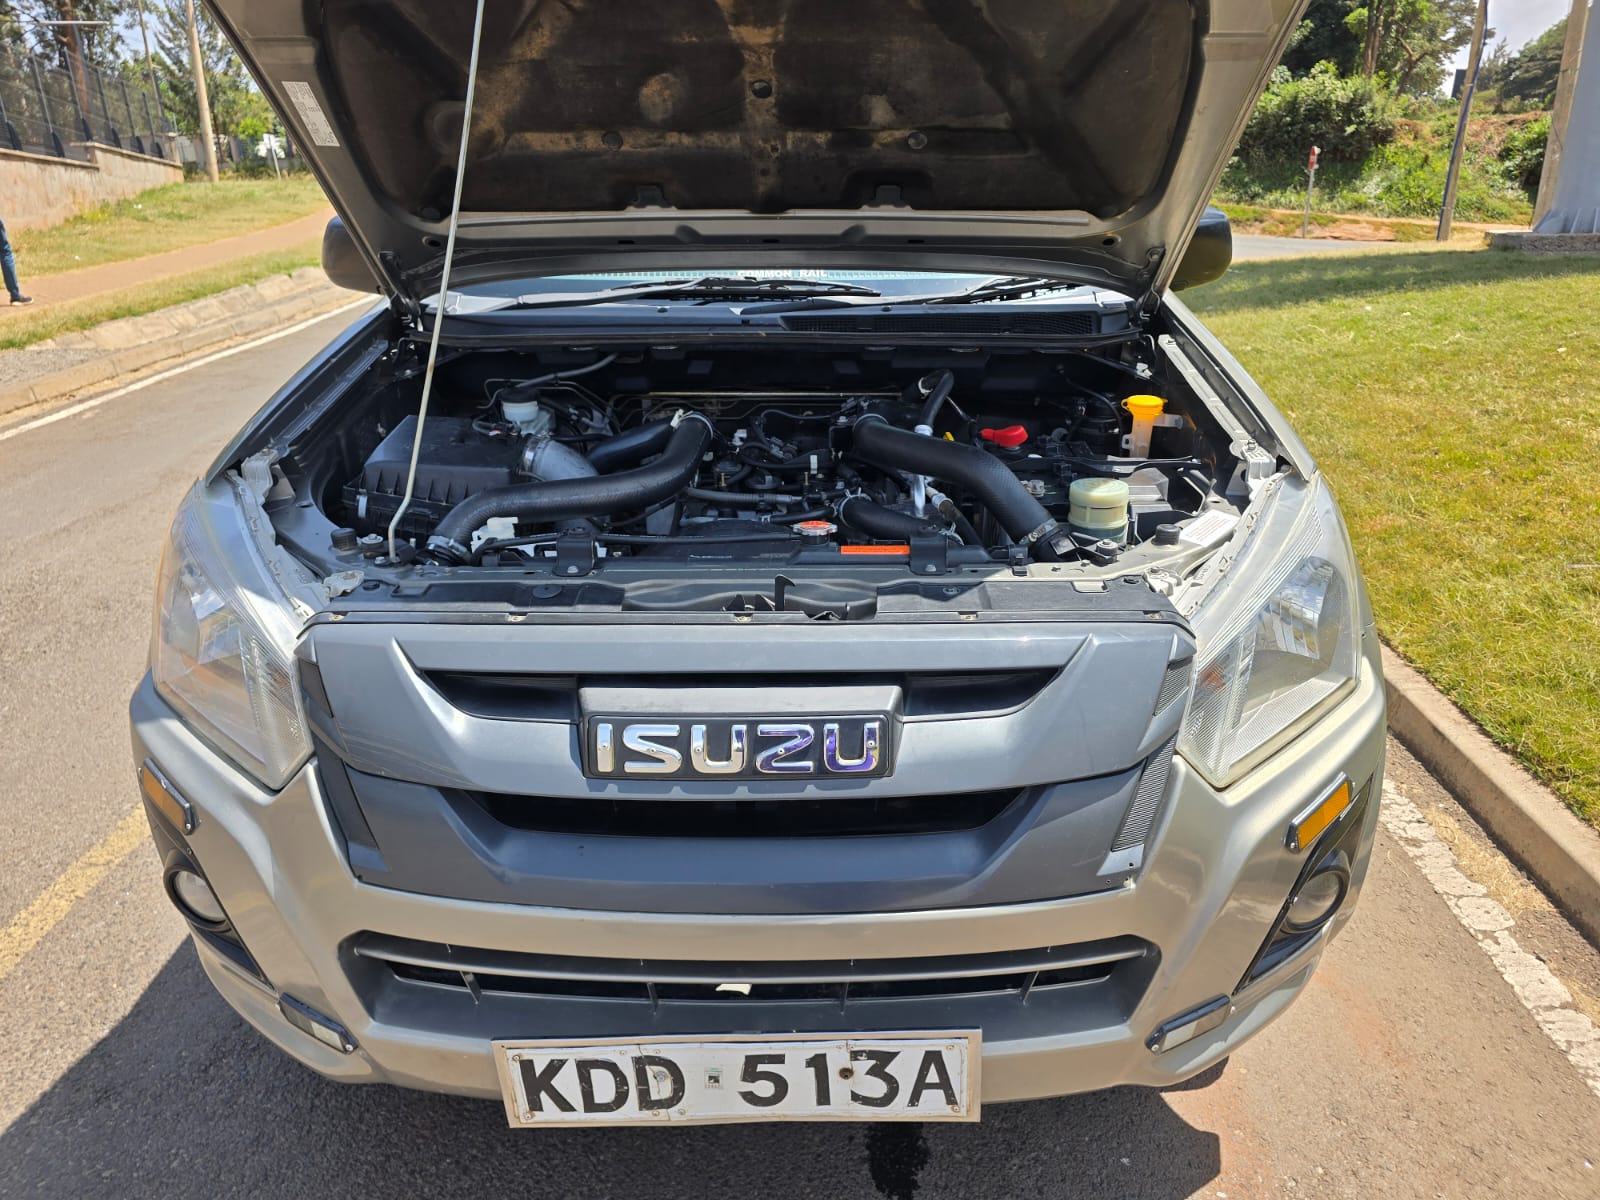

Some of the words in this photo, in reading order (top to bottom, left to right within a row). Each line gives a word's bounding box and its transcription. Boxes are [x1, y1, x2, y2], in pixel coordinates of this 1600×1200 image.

[736, 269, 792, 278] COMMON
[800, 269, 828, 278] RAIL
[596, 723, 881, 774] ISUZU
[518, 1055, 686, 1114] KDD
[738, 1049, 959, 1108] 513A
